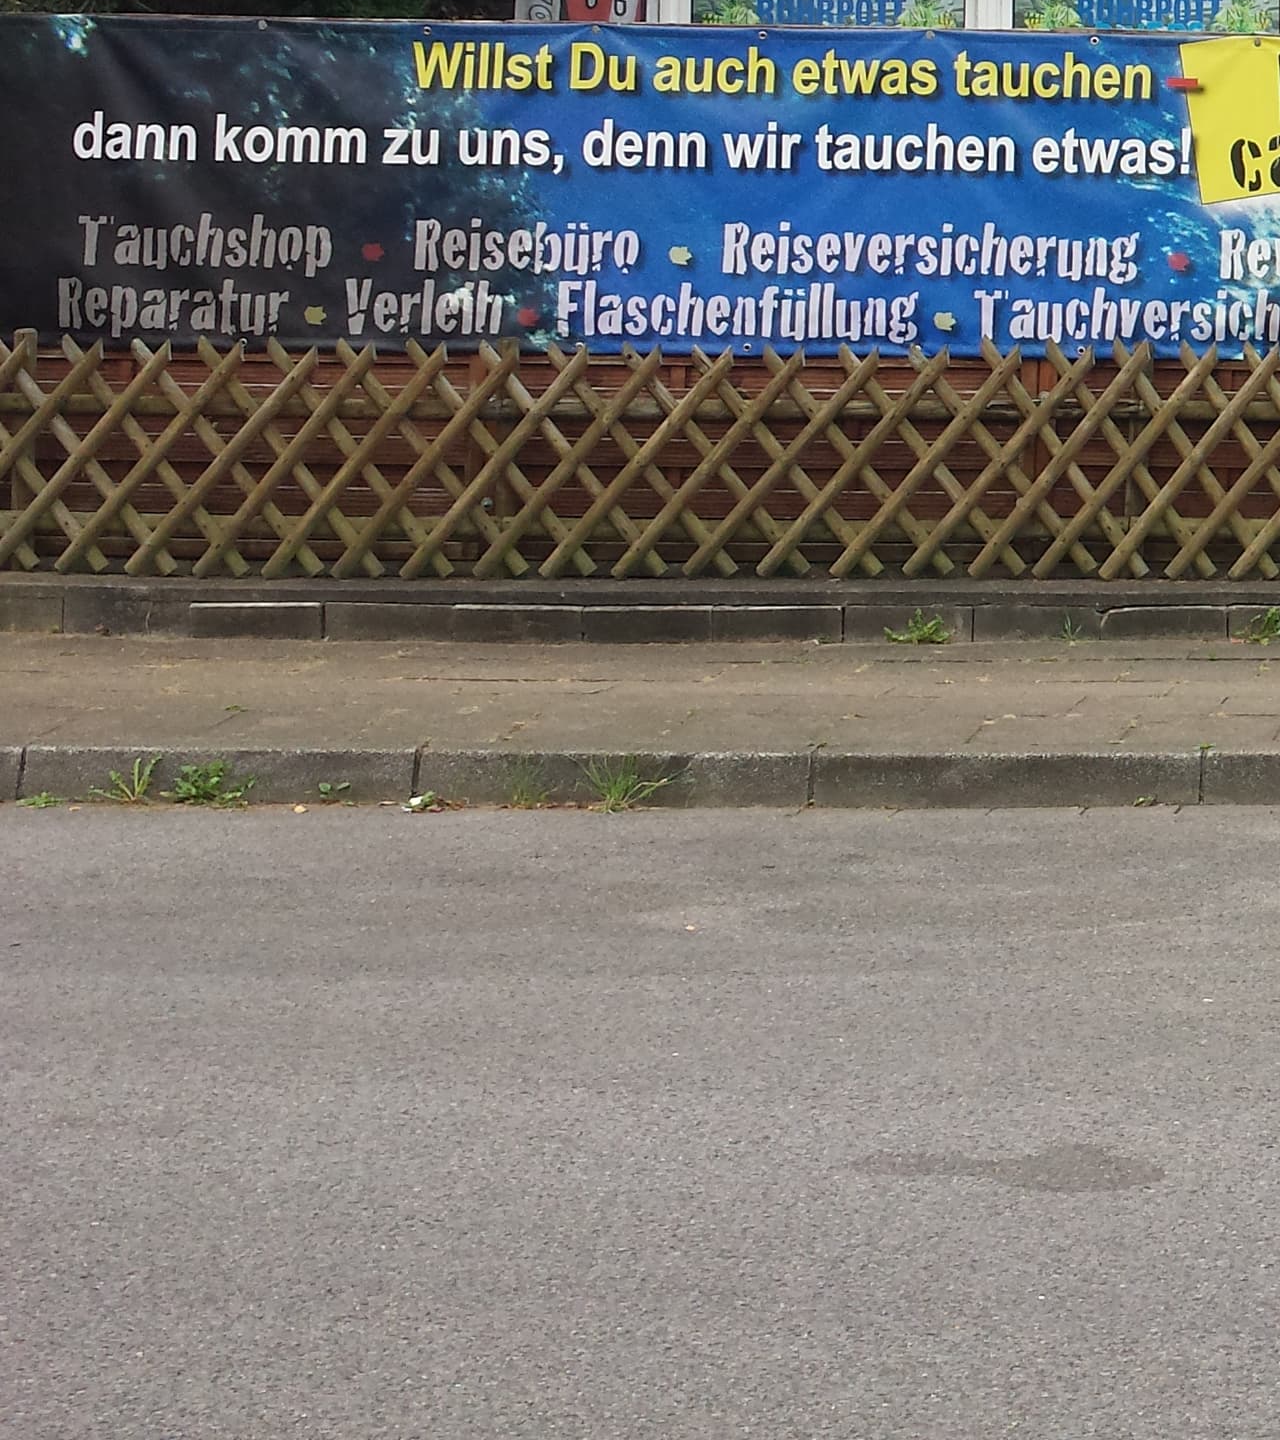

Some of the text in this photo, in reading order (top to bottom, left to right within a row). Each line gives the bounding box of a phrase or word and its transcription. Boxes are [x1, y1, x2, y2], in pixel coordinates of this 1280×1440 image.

[413, 41, 553, 90] Willst
[569, 42, 636, 91] Du
[653, 46, 776, 93] auch
[793, 49, 938, 96] etwas
[954, 50, 1153, 100] tauchen
[73, 111, 1192, 175] dann komm zu uns, denn wir tauchen etwas!
[78, 212, 333, 278] Tauchshop
[414, 217, 640, 275] Reisebüro
[722, 221, 1140, 285] Reiseversicherung
[57, 276, 290, 338] Reparatur
[345, 278, 503, 335] Verleih
[557, 280, 919, 344] Flaschenfüllung
